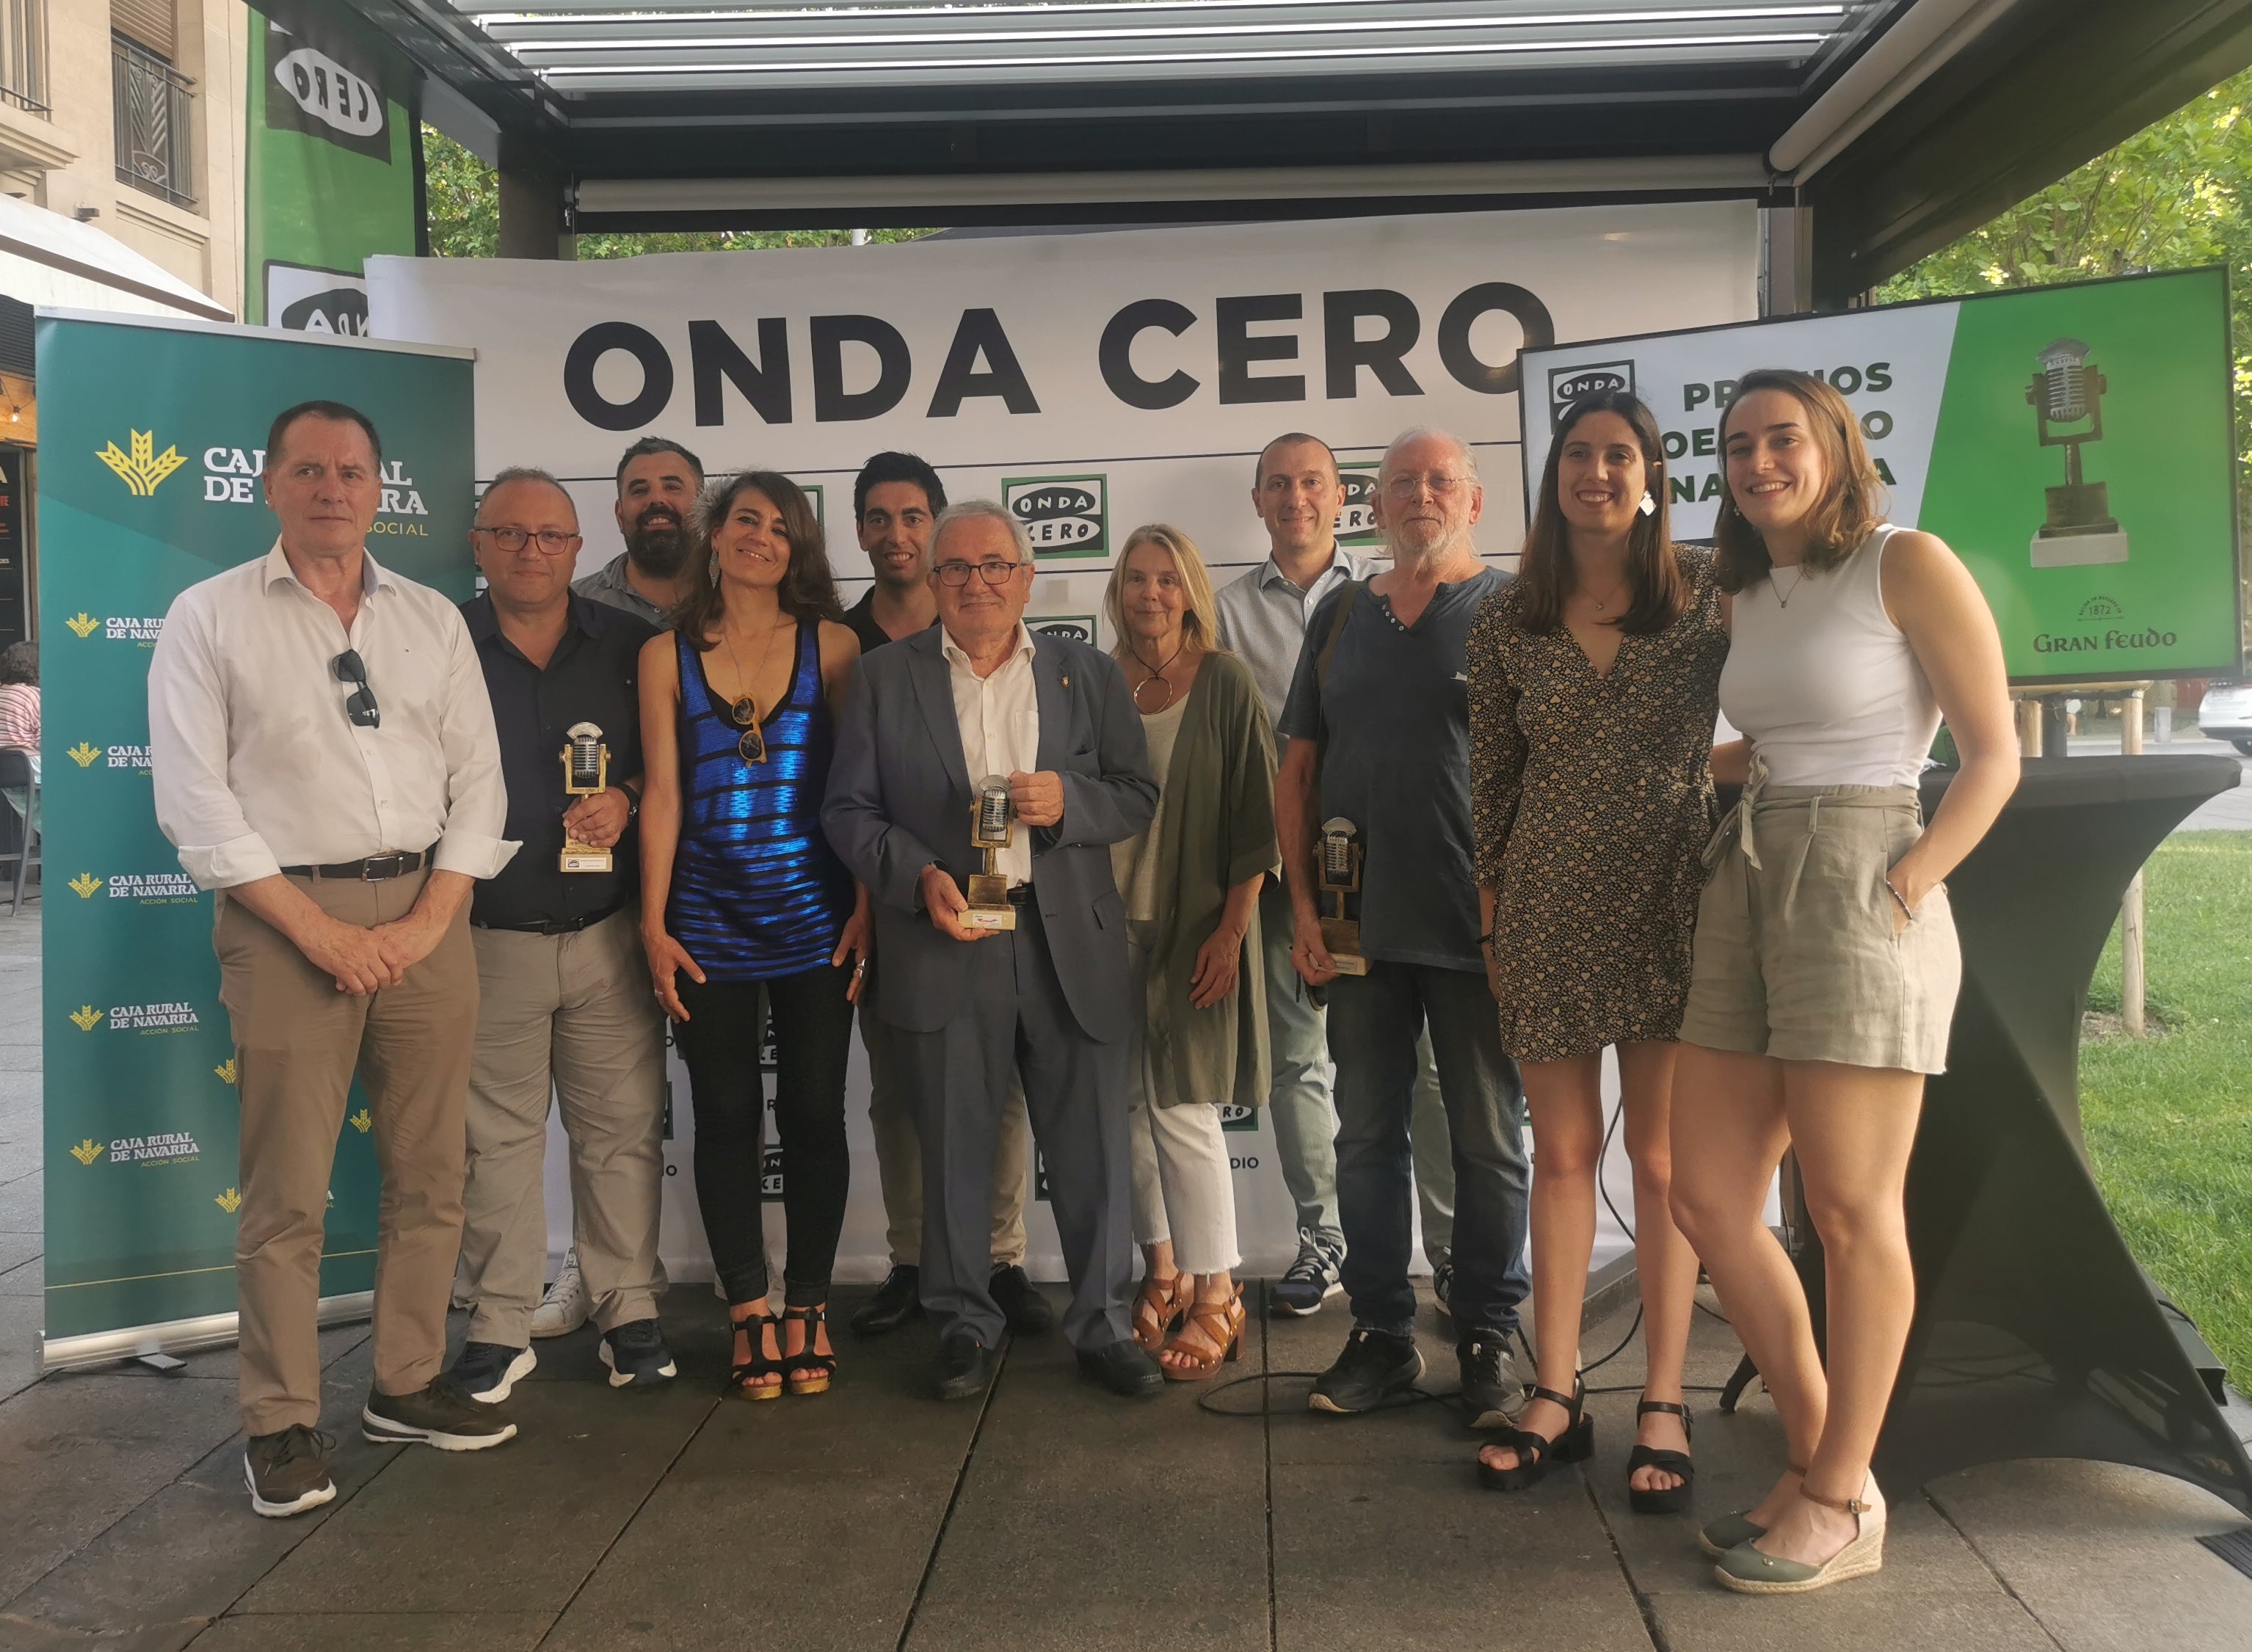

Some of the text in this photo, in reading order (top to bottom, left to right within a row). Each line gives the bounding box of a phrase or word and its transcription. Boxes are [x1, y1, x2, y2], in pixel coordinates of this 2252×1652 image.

[564, 282, 1555, 432] ONDA CERO
[1563, 378, 1619, 395] ONDA
[203, 447, 266, 477] CAJ
[204, 476, 254, 503] DE
[1020, 495, 1088, 512] ONDA
[2088, 604, 2111, 616] 1872
[106, 617, 142, 629] CAJA
[106, 629, 126, 639] DE
[107, 746, 142, 757] CAJA
[107, 757, 128, 767] DE
[109, 873, 192, 887] CAJA RURAL
[109, 884, 198, 898] DE NAVARRA
[110, 1002, 192, 1018] CAJA RURAL
[110, 1013, 199, 1029] DE NAVARRA
[110, 1132, 194, 1150] CAJA RURAL
[110, 1143, 200, 1162] DE NAVARRA
